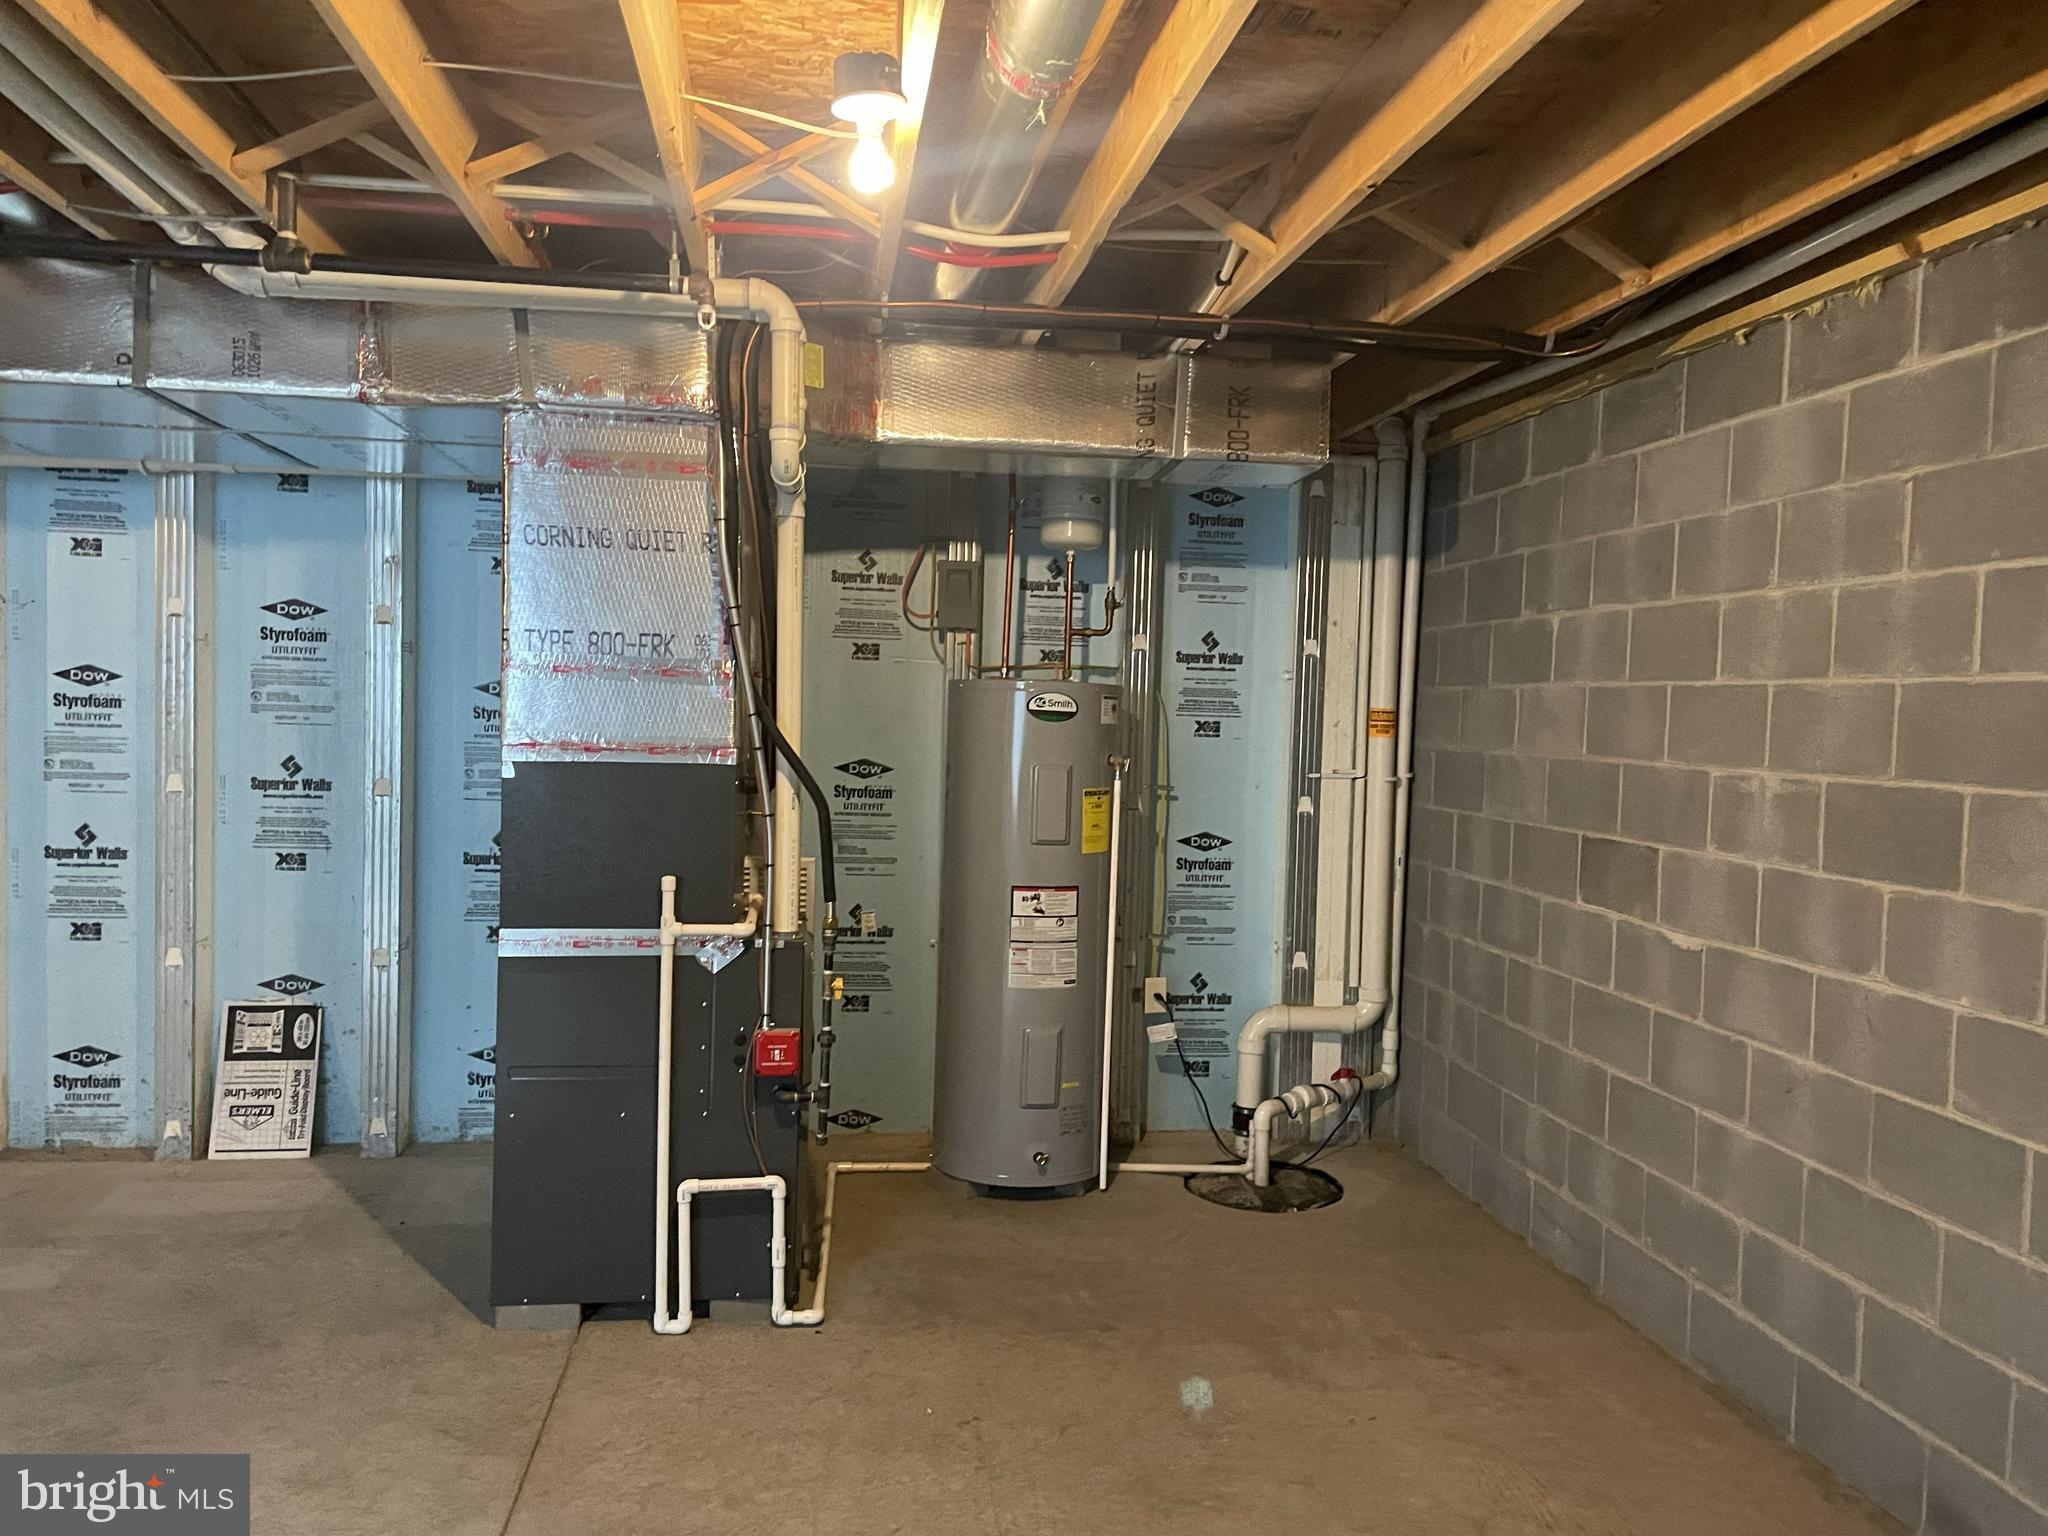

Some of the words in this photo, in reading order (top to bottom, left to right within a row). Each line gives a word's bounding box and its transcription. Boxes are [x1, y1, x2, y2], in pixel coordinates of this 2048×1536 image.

[1136, 373, 1157, 427] QUIET
[1226, 385, 1250, 462] 800-FRK
[1188, 512, 1244, 528] Styrofoam
[523, 524, 613, 549] CORNING
[626, 528, 687, 552] QUIET
[831, 569, 873, 585] Superior
[876, 572, 903, 586] Walls
[260, 626, 327, 643] Styrofoam
[272, 646, 317, 655] UTILITYFIT
[525, 628, 574, 652] TYPE
[588, 631, 675, 658] 800-FRK
[1176, 650, 1216, 665] Superior
[1218, 652, 1244, 665] Walls
[53, 692, 122, 710] Styrofoam
[1047, 699, 1073, 709] Smith
[250, 776, 299, 792] Superior
[302, 778, 333, 791] Walls
[833, 784, 893, 800] Styrofoam
[44, 845, 93, 860] Superior
[96, 847, 128, 860] Walls
[1176, 857, 1231, 872] Styrofoam
[53, 1074, 121, 1091] Styrofoam
[224, 1087, 282, 1100] Guide-Line
